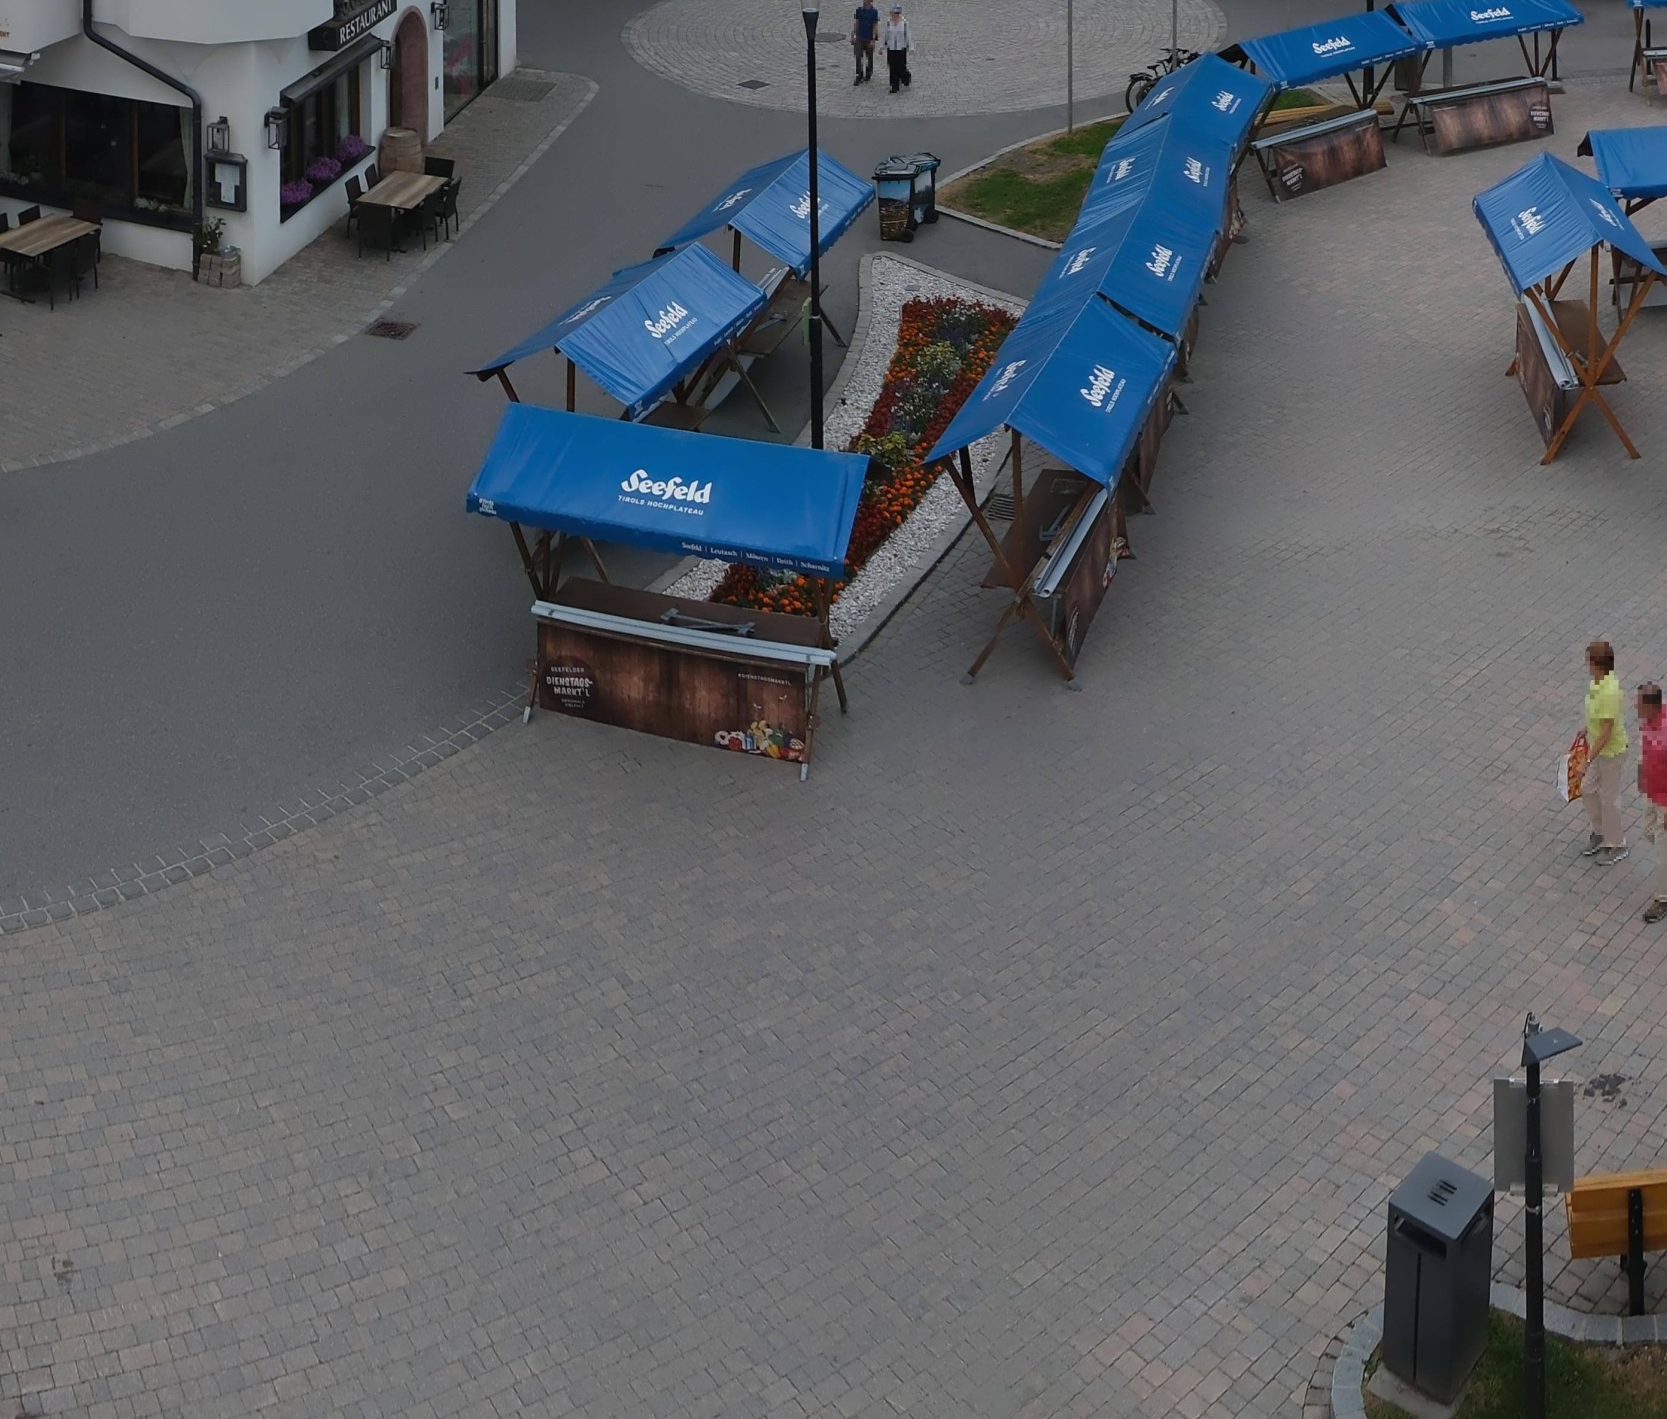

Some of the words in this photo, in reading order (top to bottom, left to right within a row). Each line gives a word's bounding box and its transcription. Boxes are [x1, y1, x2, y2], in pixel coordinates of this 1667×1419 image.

[1470, 6, 1511, 22] Seefeld
[1312, 35, 1351, 55] Seefeld
[1518, 205, 1545, 234] Seefeld
[1145, 243, 1173, 277] Seefeld
[645, 300, 689, 339] Seefeld
[1080, 364, 1116, 407] Seefeld
[620, 468, 713, 505] Seefeld
[617, 494, 646, 506] TIROLS
[646, 499, 705, 516] HOCHPLATEAU
[681, 541, 703, 552] Seefeld
[710, 547, 738, 557] Leutasch
[745, 552, 769, 562] Mösern
[776, 557, 794, 566] Reith
[800, 561, 830, 572] Scharnitz
[546, 676, 593, 690] DIENSTAGS-
[554, 686, 590, 698] MARKT'L
